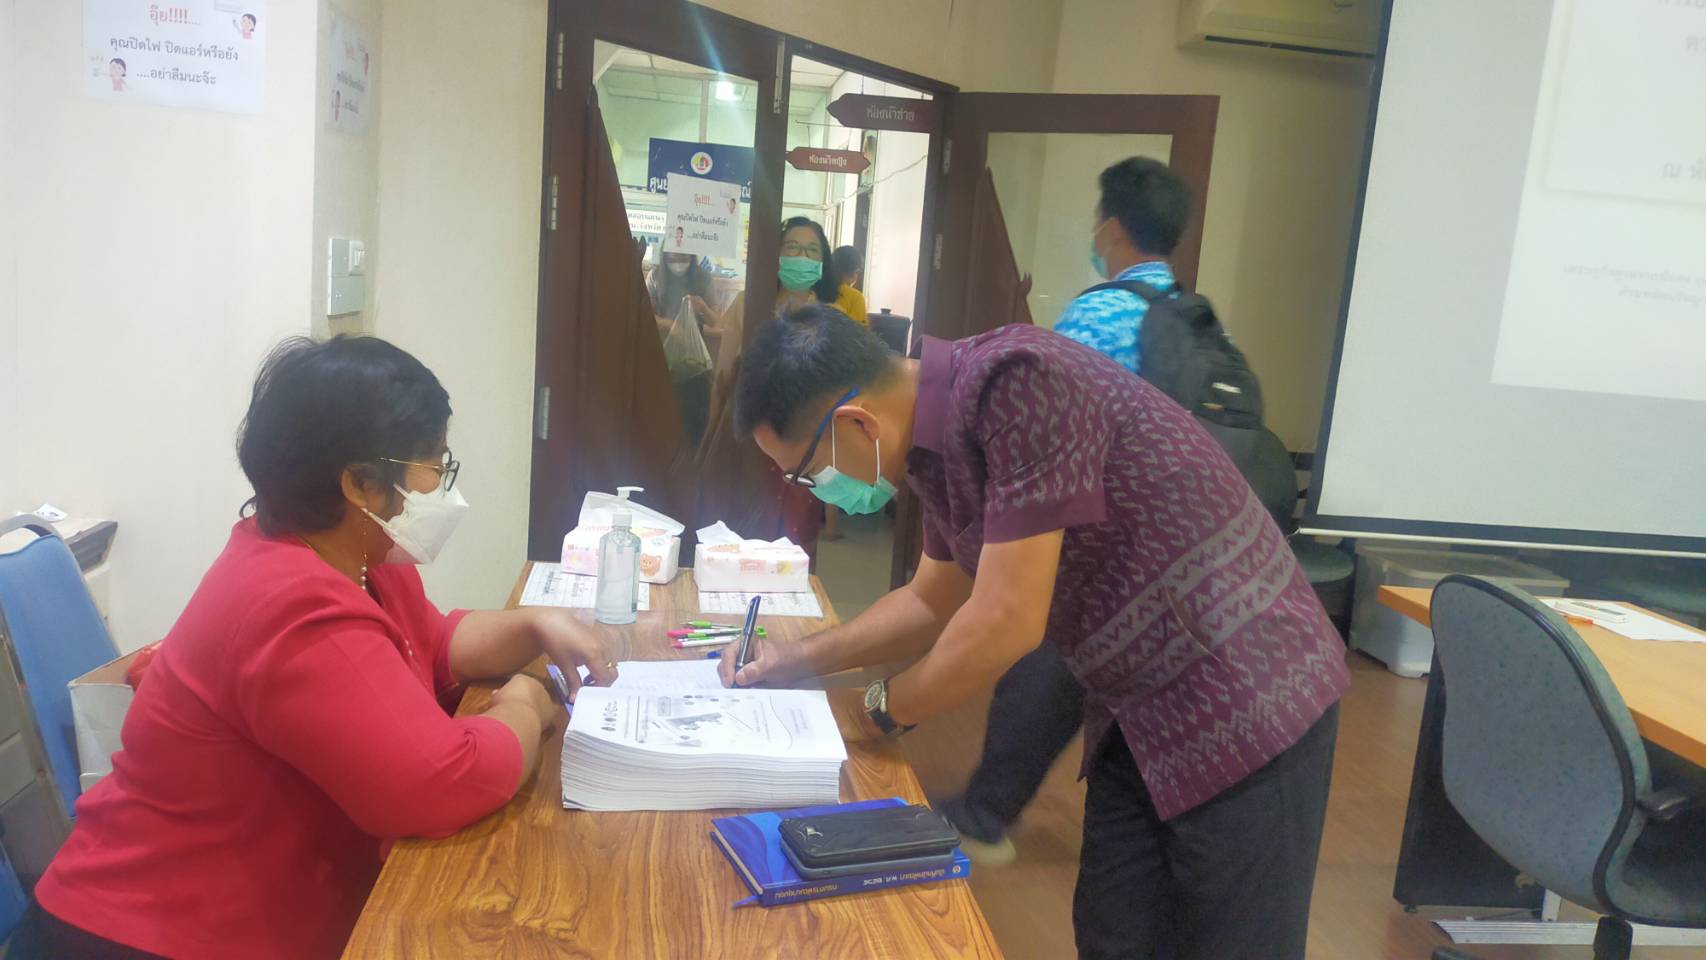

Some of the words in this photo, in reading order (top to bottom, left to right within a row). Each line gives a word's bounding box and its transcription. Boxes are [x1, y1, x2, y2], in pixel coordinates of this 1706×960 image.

[110, 36, 161, 52] คุณปิดไฟ
[165, 40, 239, 61] ปิดแอร์หรือยัง
[866, 104, 915, 121] ห้องน้ำชาย
[809, 154, 848, 168] ห้องน้ำหญิง
